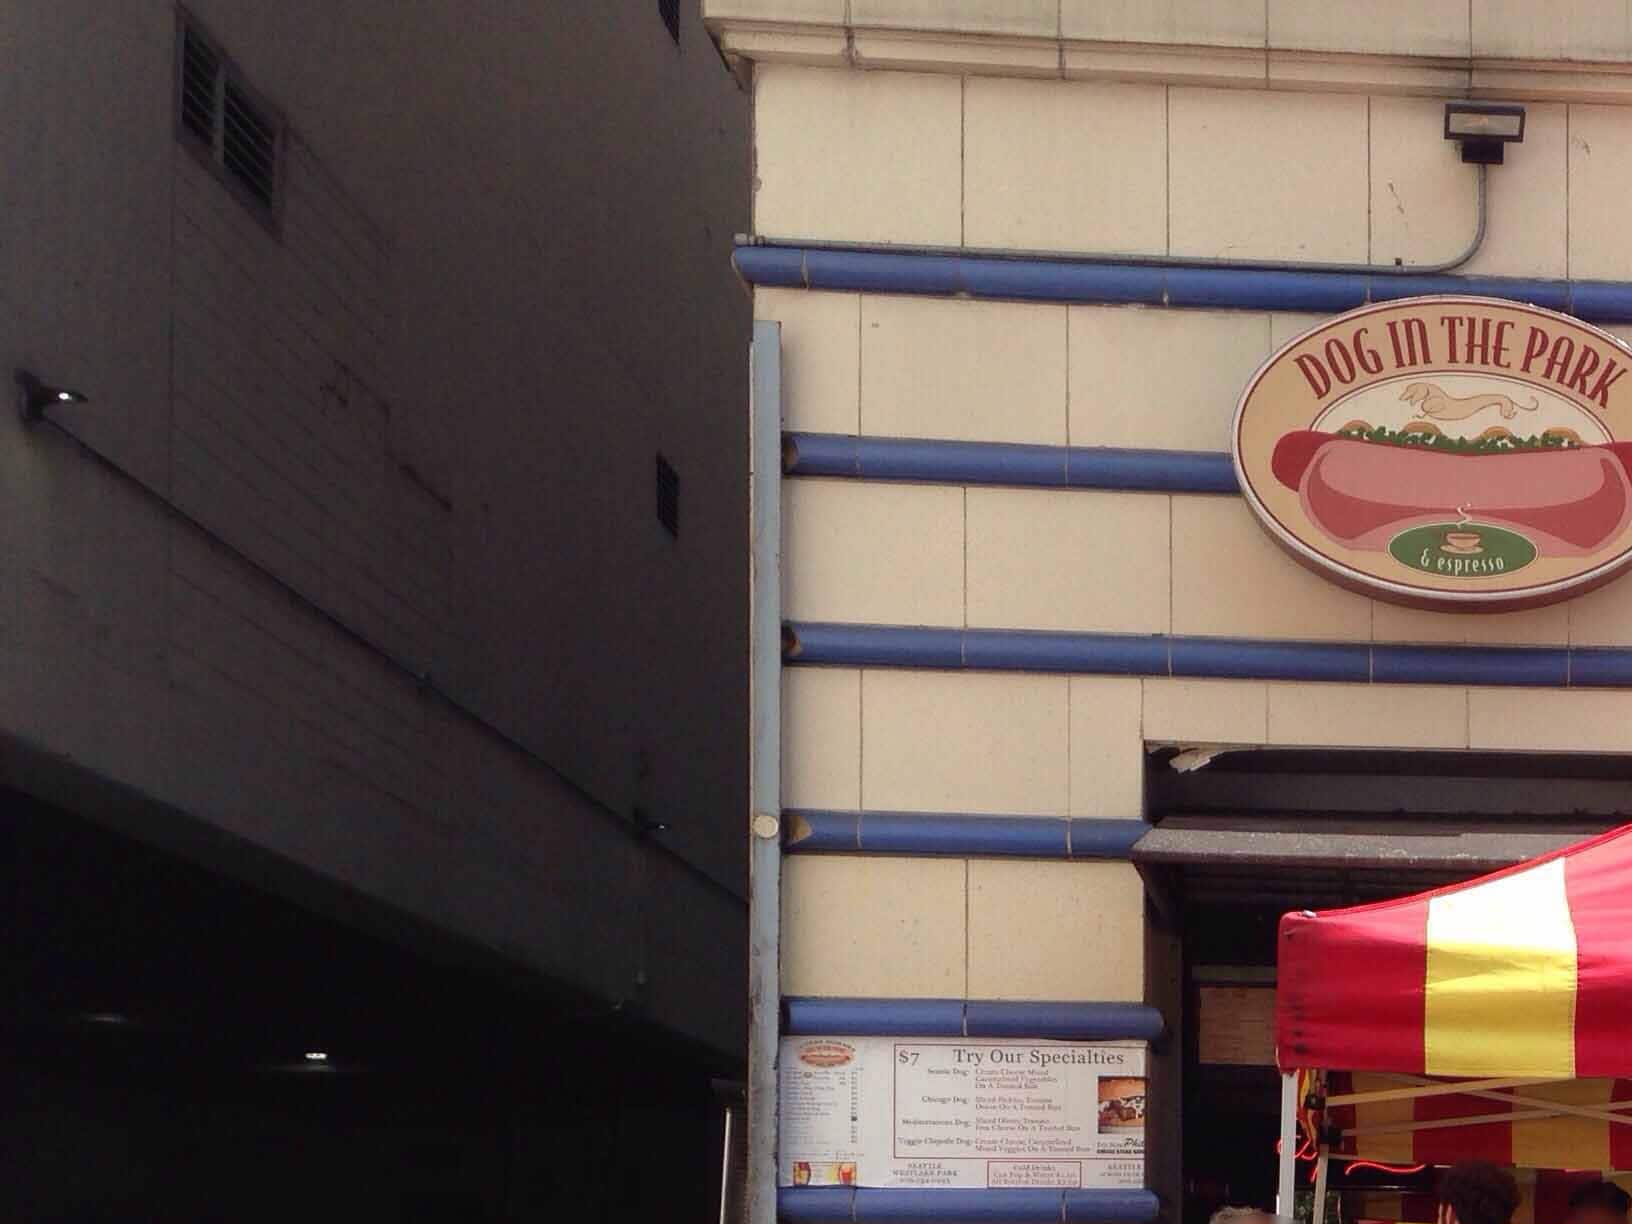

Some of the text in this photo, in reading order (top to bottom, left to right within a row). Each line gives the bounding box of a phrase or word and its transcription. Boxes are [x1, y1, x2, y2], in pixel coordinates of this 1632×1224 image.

[1293, 316, 1629, 410] DOG IN THE PARK
[1437, 555, 1506, 577] espresso
[899, 1049, 1124, 1067] $7 Try Our Specialties
